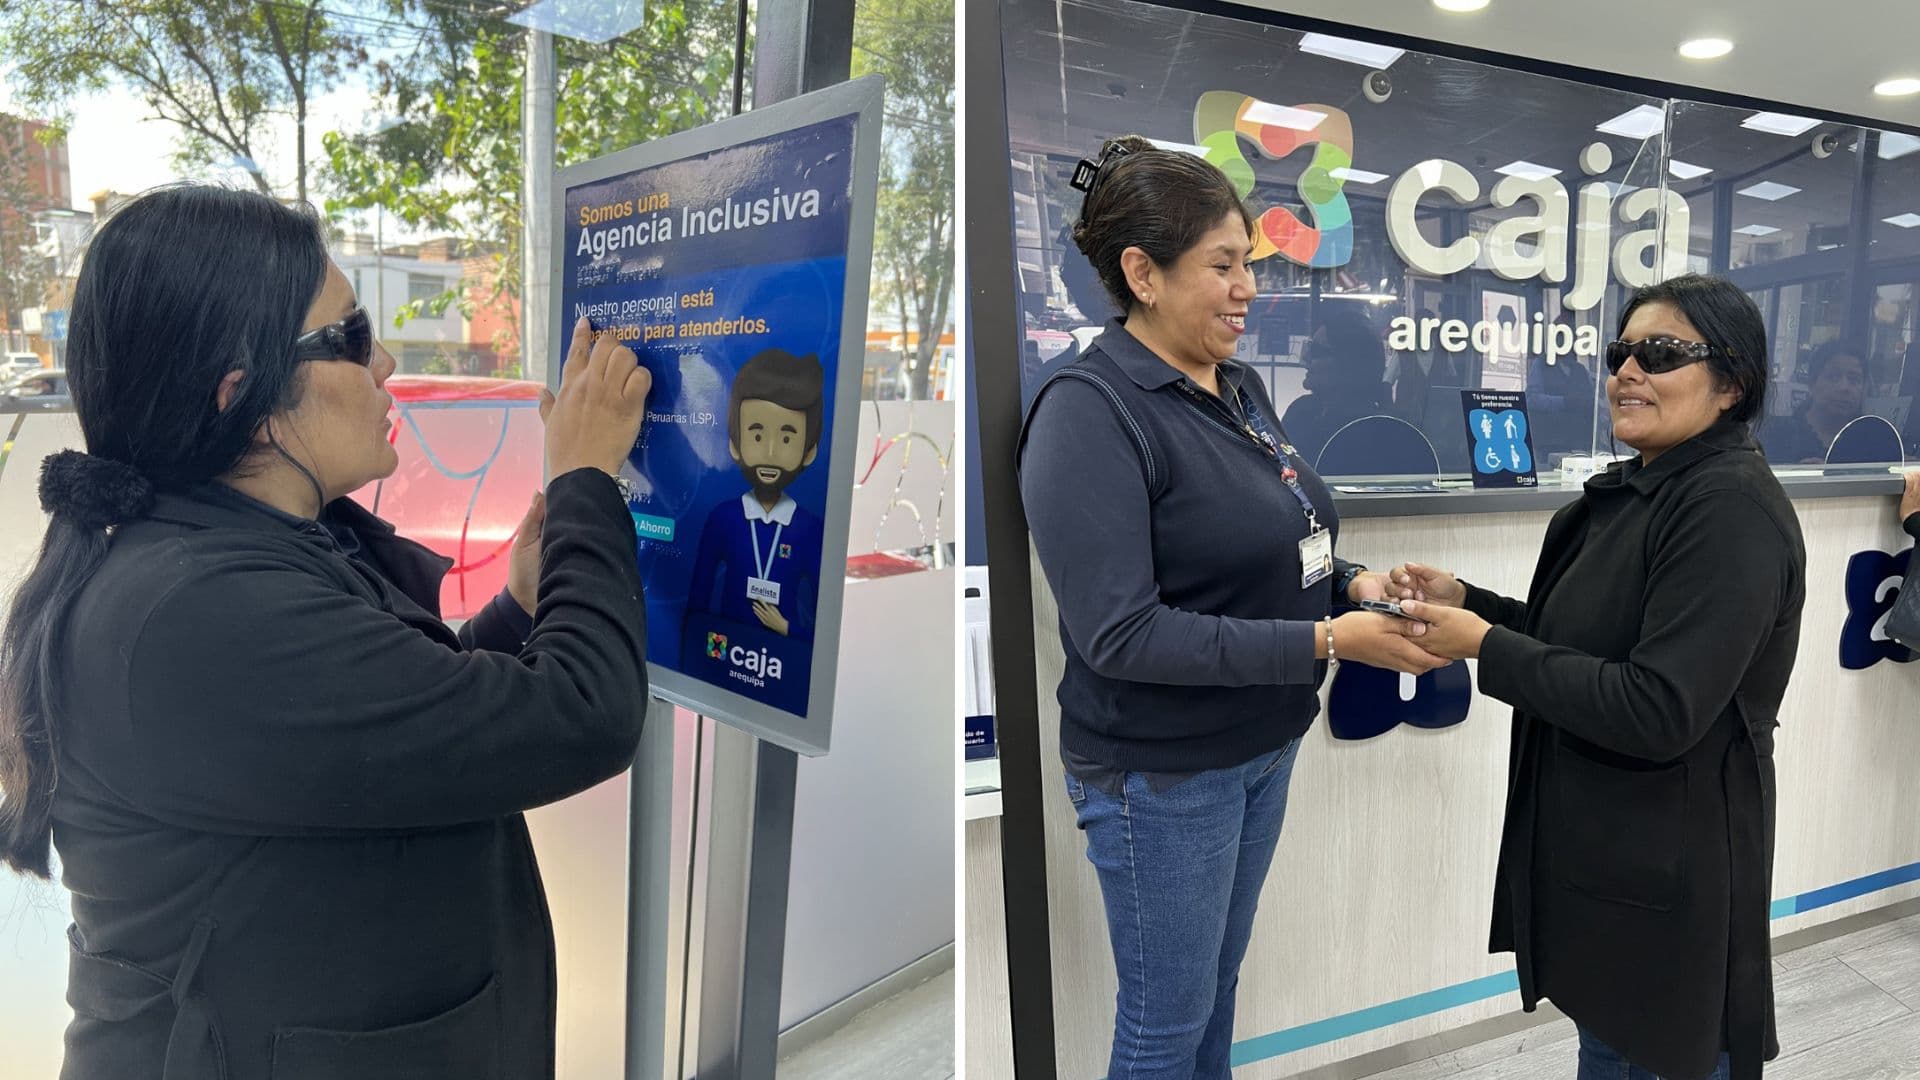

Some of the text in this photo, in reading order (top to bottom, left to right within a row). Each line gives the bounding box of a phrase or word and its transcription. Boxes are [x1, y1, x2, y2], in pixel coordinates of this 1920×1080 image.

[576, 186, 820, 261] Agencia Inclusiva
[580, 192, 670, 227] Somos una
[1385, 141, 1691, 311] caja
[574, 286, 715, 318] Nuestro personal está
[644, 323, 676, 344] para
[679, 315, 771, 337] atenderlos.
[1388, 312, 1598, 366] arequipa
[646, 411, 719, 428] Peruanas (LSP).
[639, 519, 671, 535] Ahorro
[729, 645, 783, 680] caja
[729, 669, 765, 688] arequipa
